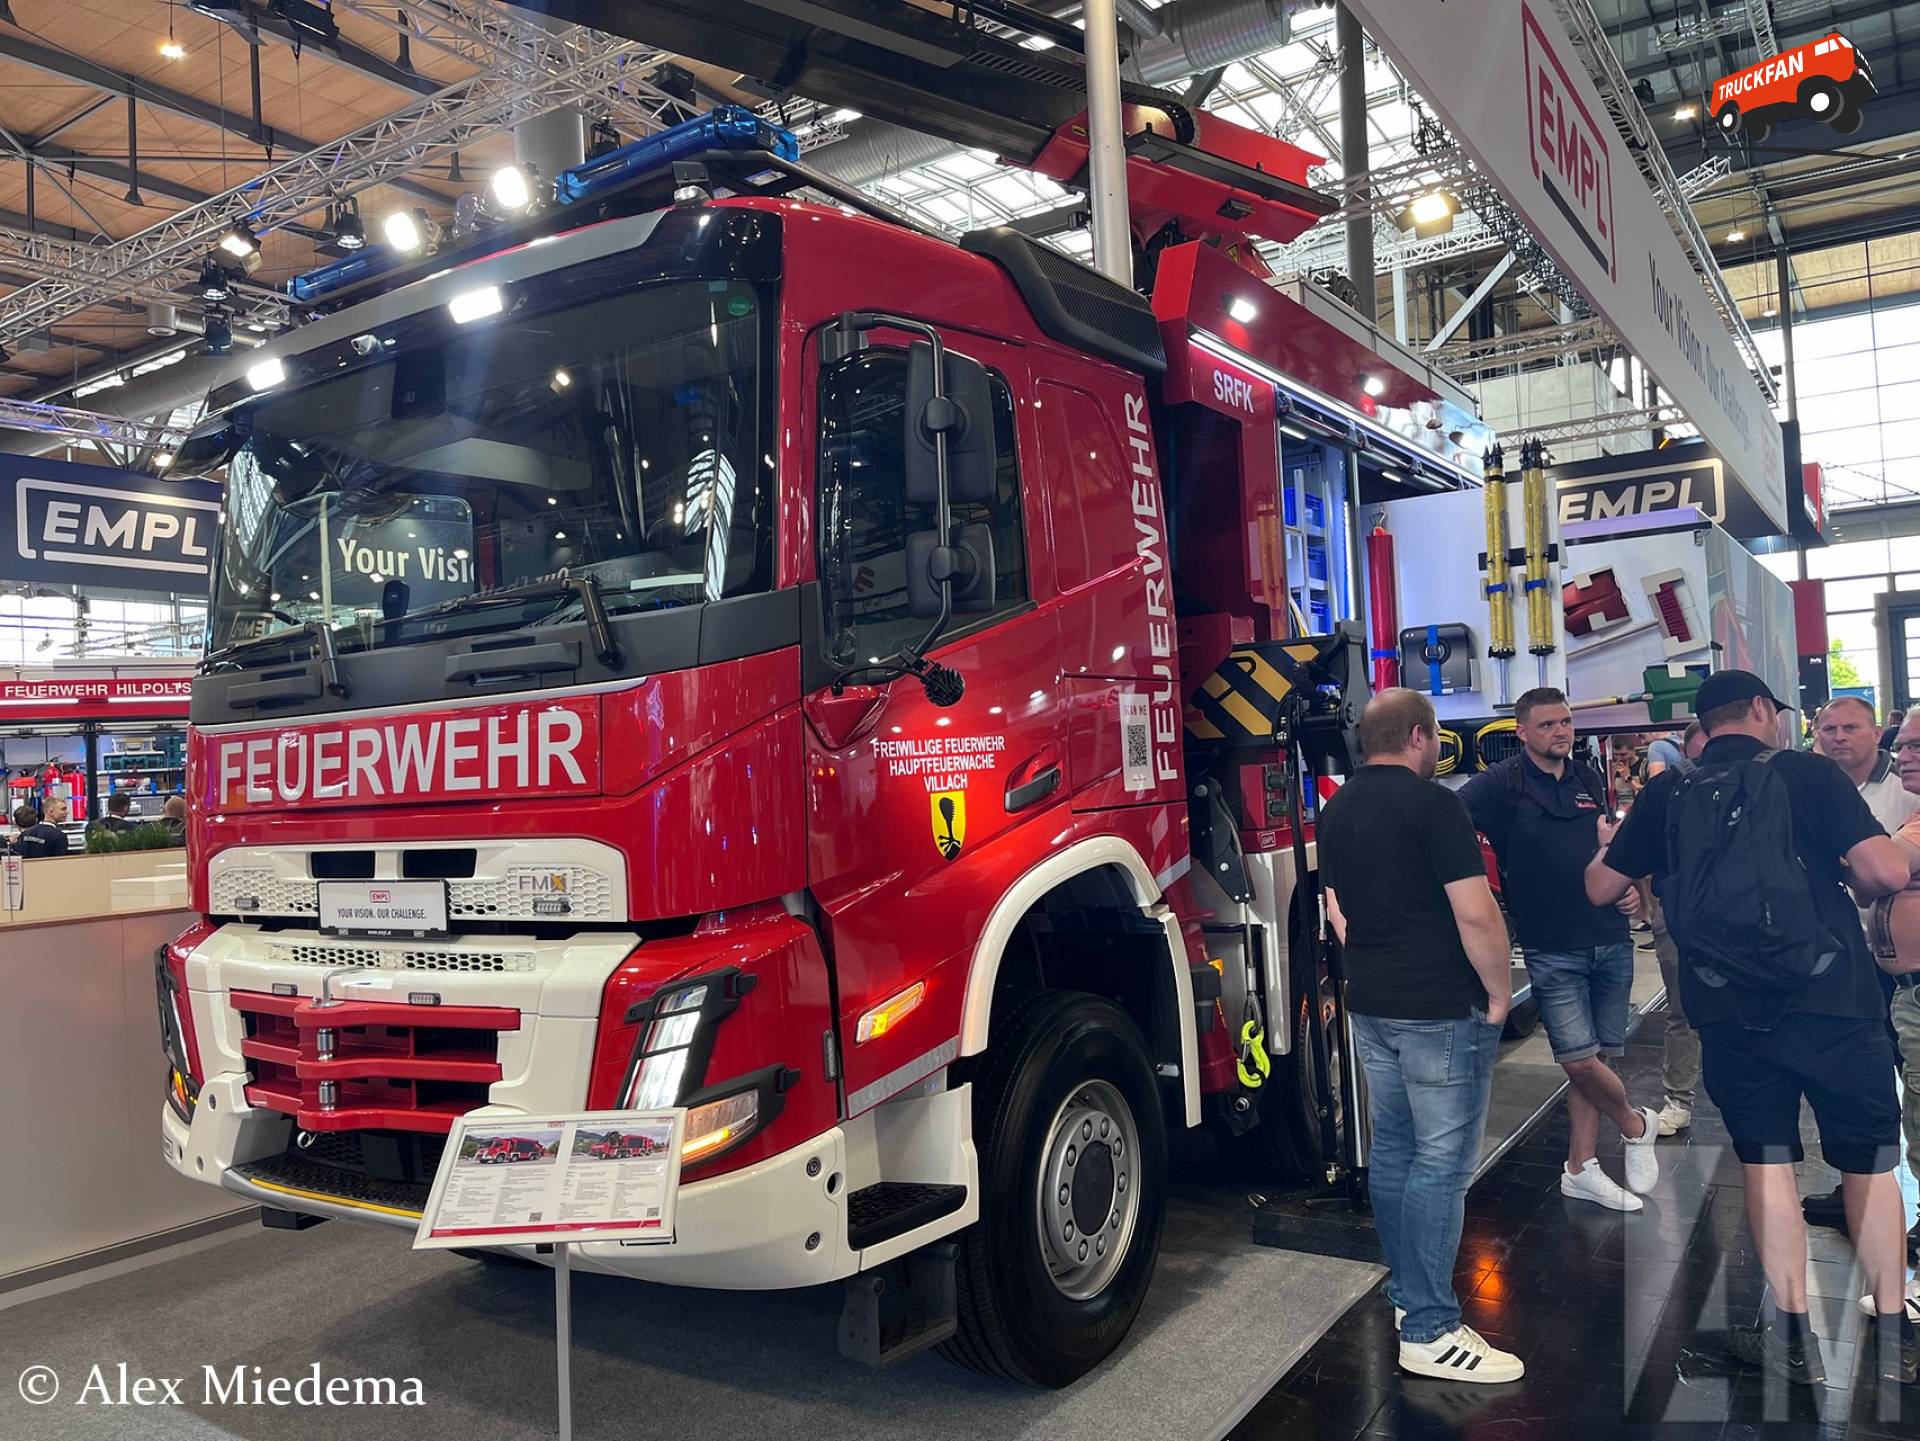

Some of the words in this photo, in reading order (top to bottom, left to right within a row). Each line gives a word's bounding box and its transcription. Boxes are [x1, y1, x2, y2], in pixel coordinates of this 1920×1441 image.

[1538, 64, 1607, 240] EMPL
[1649, 251, 1674, 339] Your
[1213, 369, 1254, 414] SRFK
[1559, 478, 1703, 526] EMPL
[43, 500, 208, 557] EMPL
[337, 537, 410, 577] Your
[1123, 392, 1178, 780] FEUERWEHR
[4, 684, 109, 698] FEUERWEHR
[220, 710, 587, 805] FEUERWEHR
[872, 740, 944, 758] FREIWILLIGE
[944, 735, 1006, 754] FEUERWEHR
[889, 753, 996, 777] HAUPTFEUERWACHE
[923, 773, 969, 793] VILLACH
[338, 908, 353, 919] YOUR
[376, 908, 391, 919] OUR
